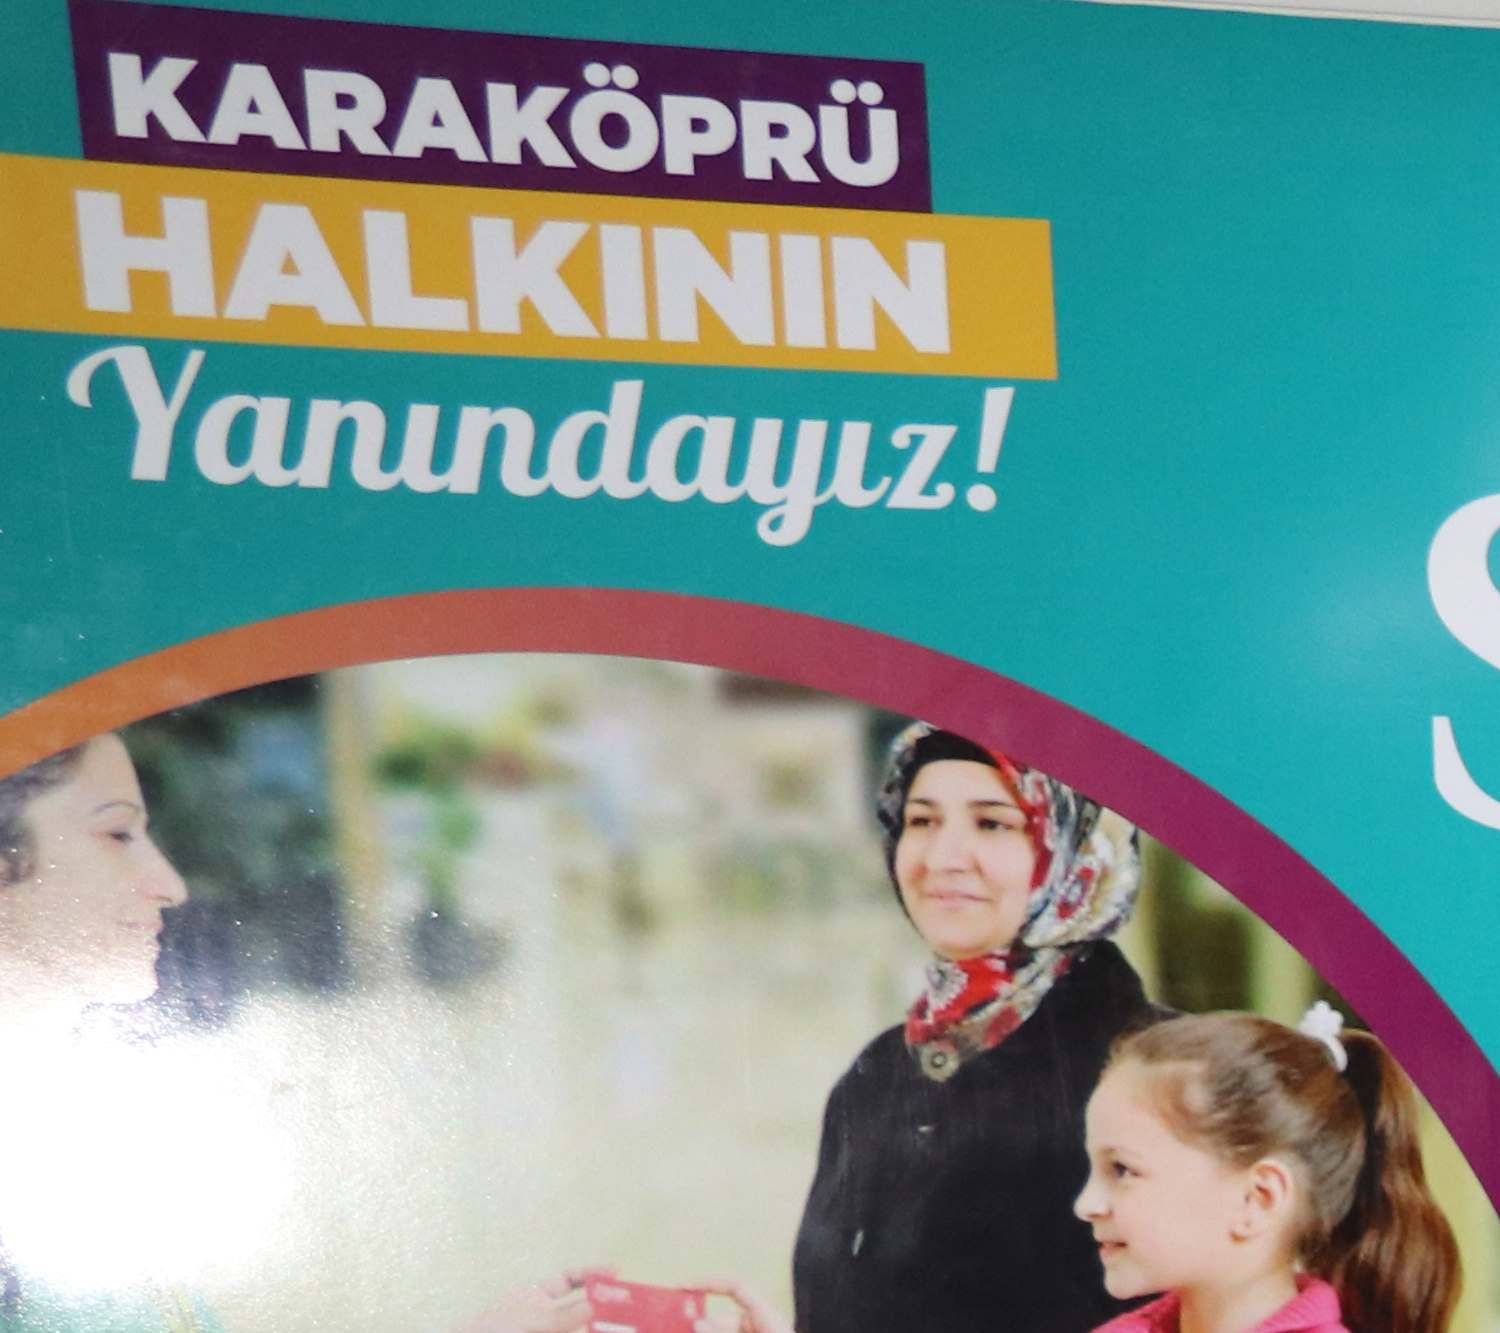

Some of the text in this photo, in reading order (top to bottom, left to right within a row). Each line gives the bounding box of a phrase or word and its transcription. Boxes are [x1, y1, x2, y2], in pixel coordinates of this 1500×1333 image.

[108, 52, 900, 188] KARAKÖPRÜ
[73, 189, 951, 354] HALKININ
[66, 345, 1015, 547] Yanındayız!
